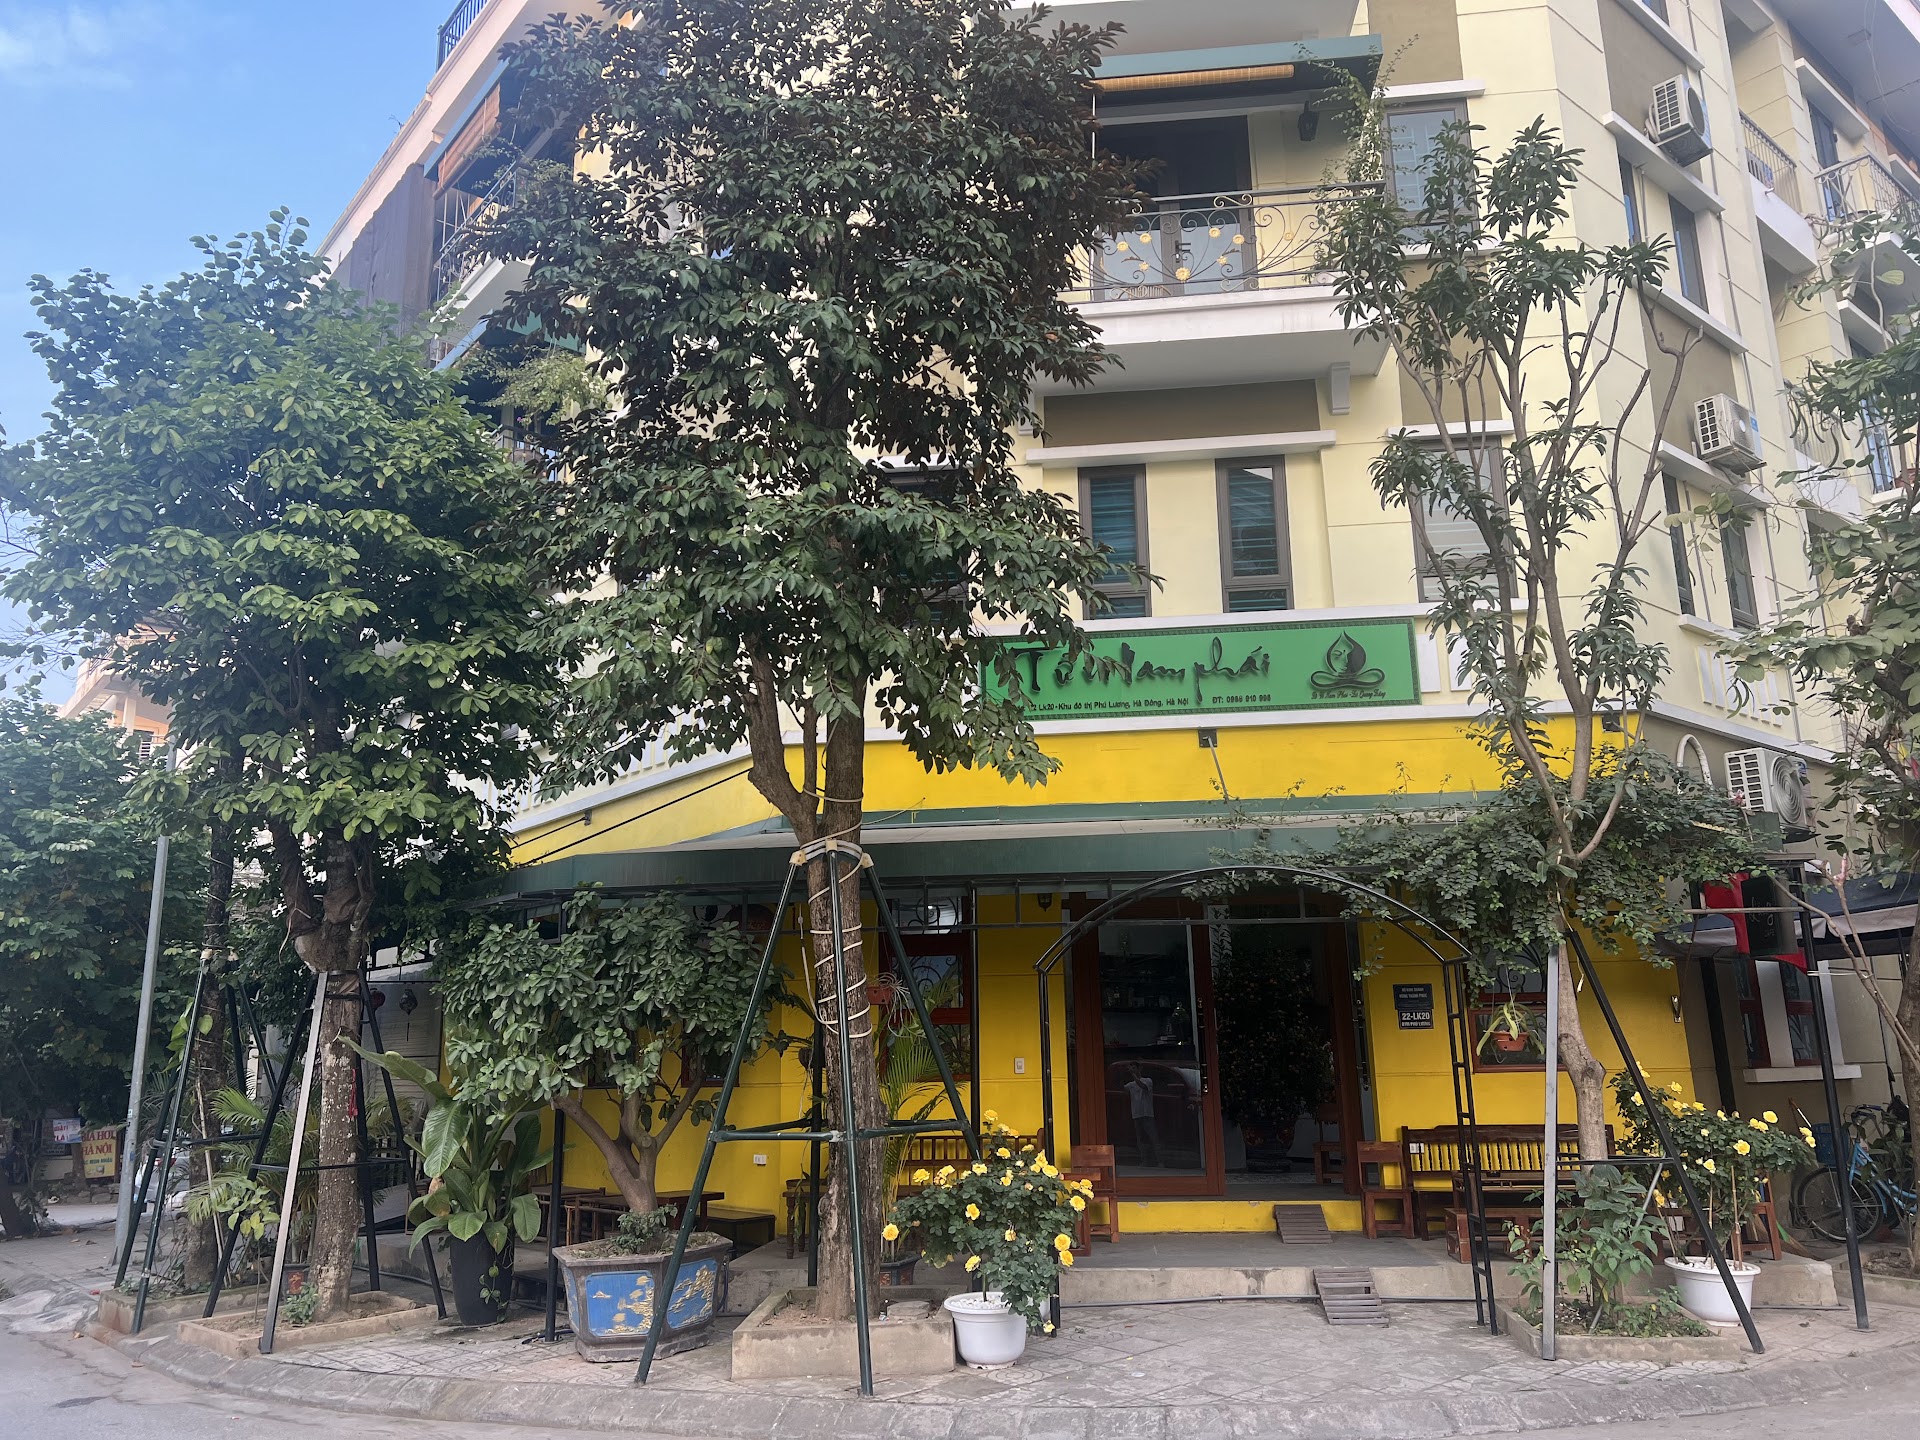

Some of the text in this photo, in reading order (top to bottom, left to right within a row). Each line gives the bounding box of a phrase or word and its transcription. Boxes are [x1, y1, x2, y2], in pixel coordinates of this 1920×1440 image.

[1058, 702, 1072, 710] Khu
[1133, 699, 1142, 707] Hà
[1166, 698, 1175, 706] Hà
[82, 1142, 113, 1156] HÀ NỘI
